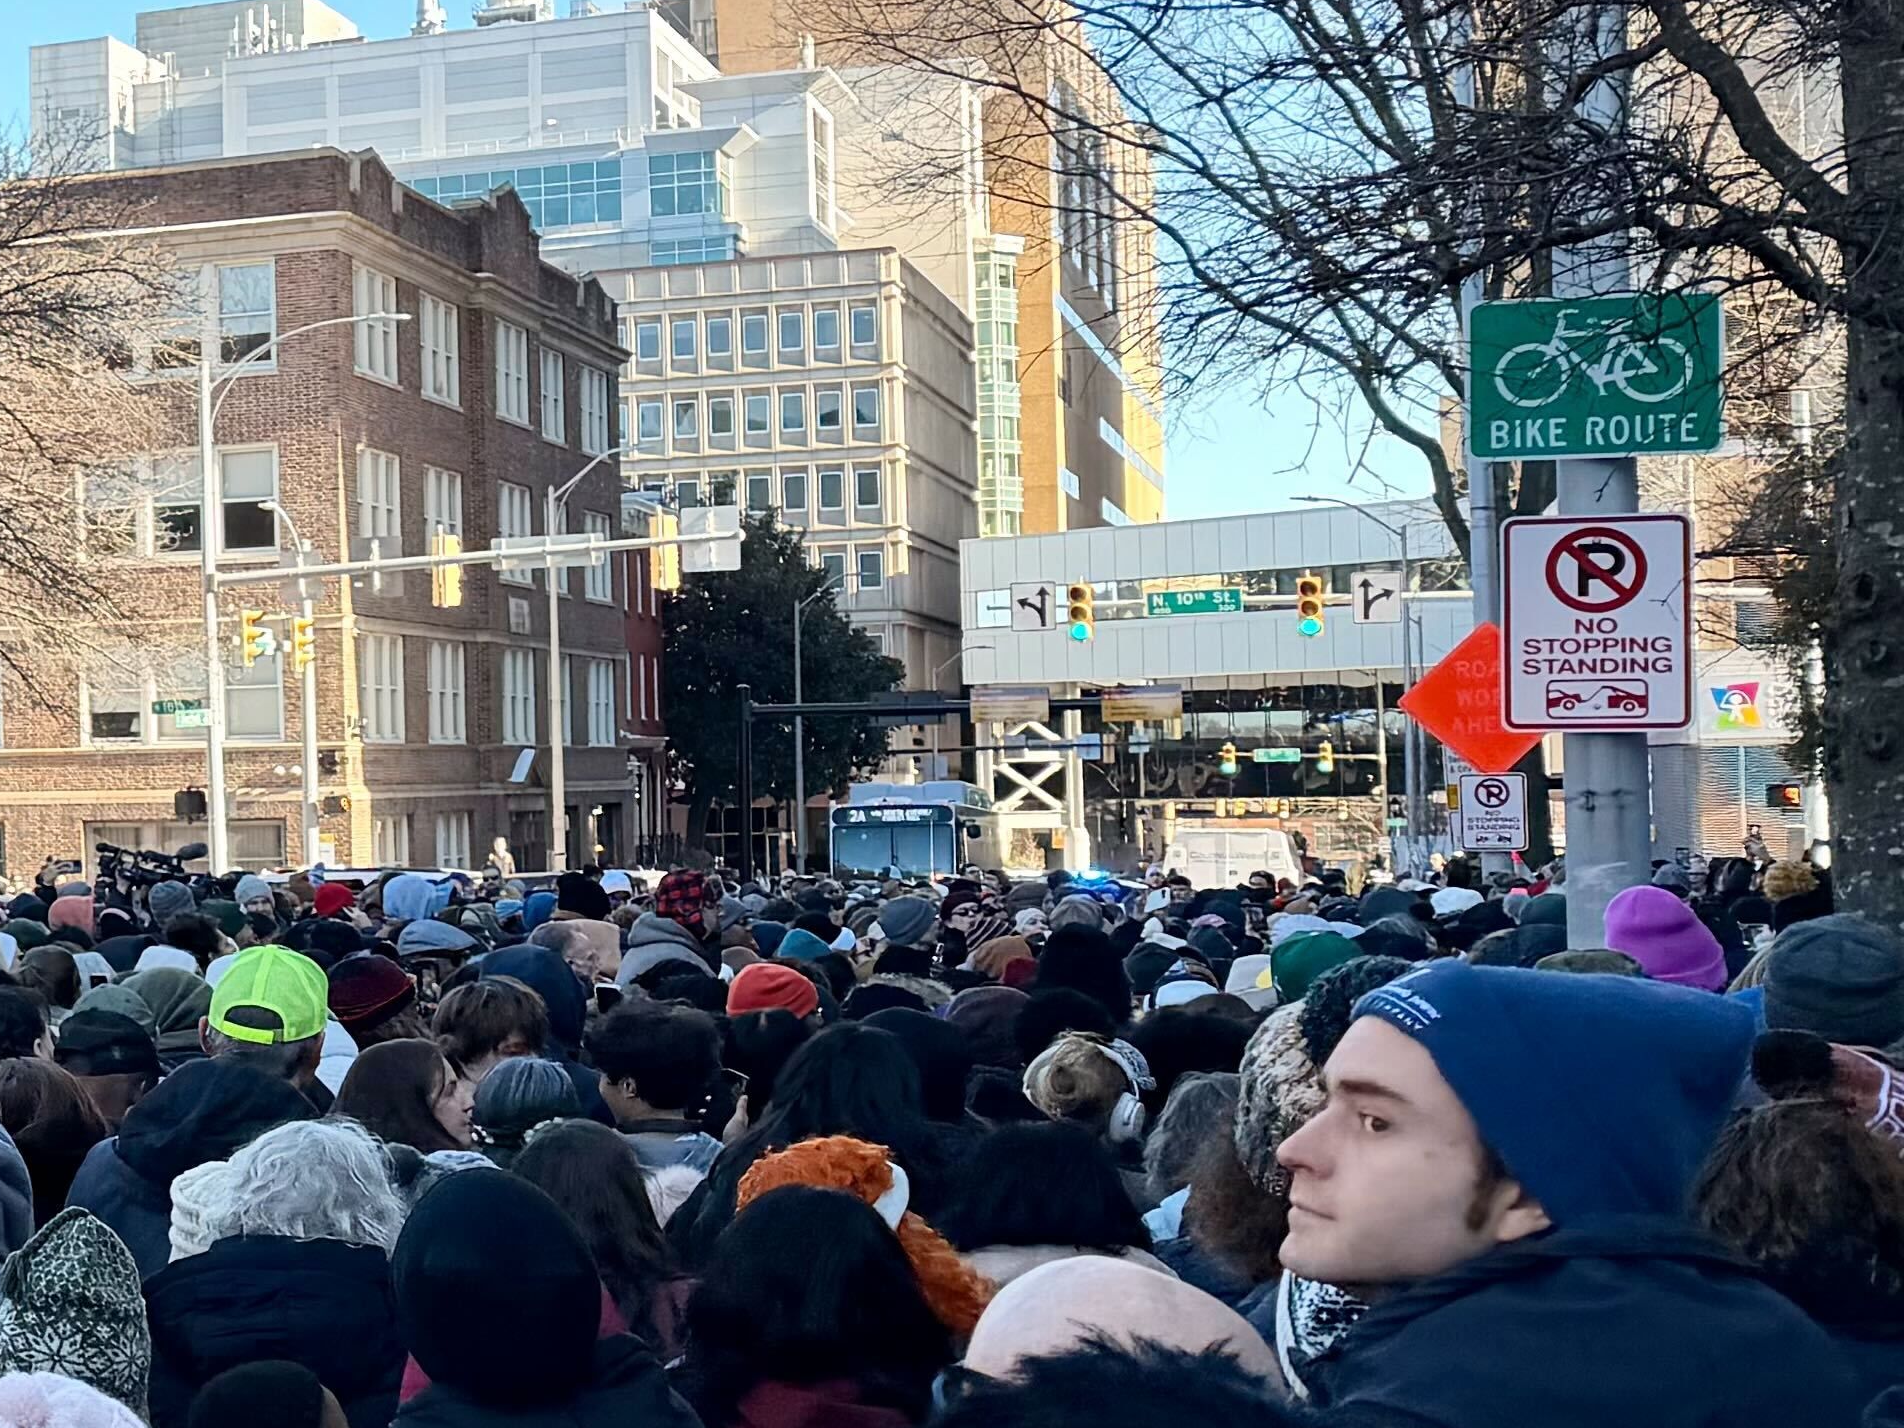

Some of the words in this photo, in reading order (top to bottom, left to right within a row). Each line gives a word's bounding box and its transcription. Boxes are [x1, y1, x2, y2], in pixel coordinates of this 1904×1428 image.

[1490, 418, 1567, 449] BIKE
[1585, 412, 1699, 446] ROUTE
[1176, 592, 1206, 605] 10th
[1212, 591, 1235, 604] St.
[1574, 617, 1618, 634] NO
[1522, 636, 1673, 655] STOPPING
[1454, 659, 1500, 679] ROA
[1522, 657, 1673, 675] STANDING
[1452, 715, 1497, 735] AHE
